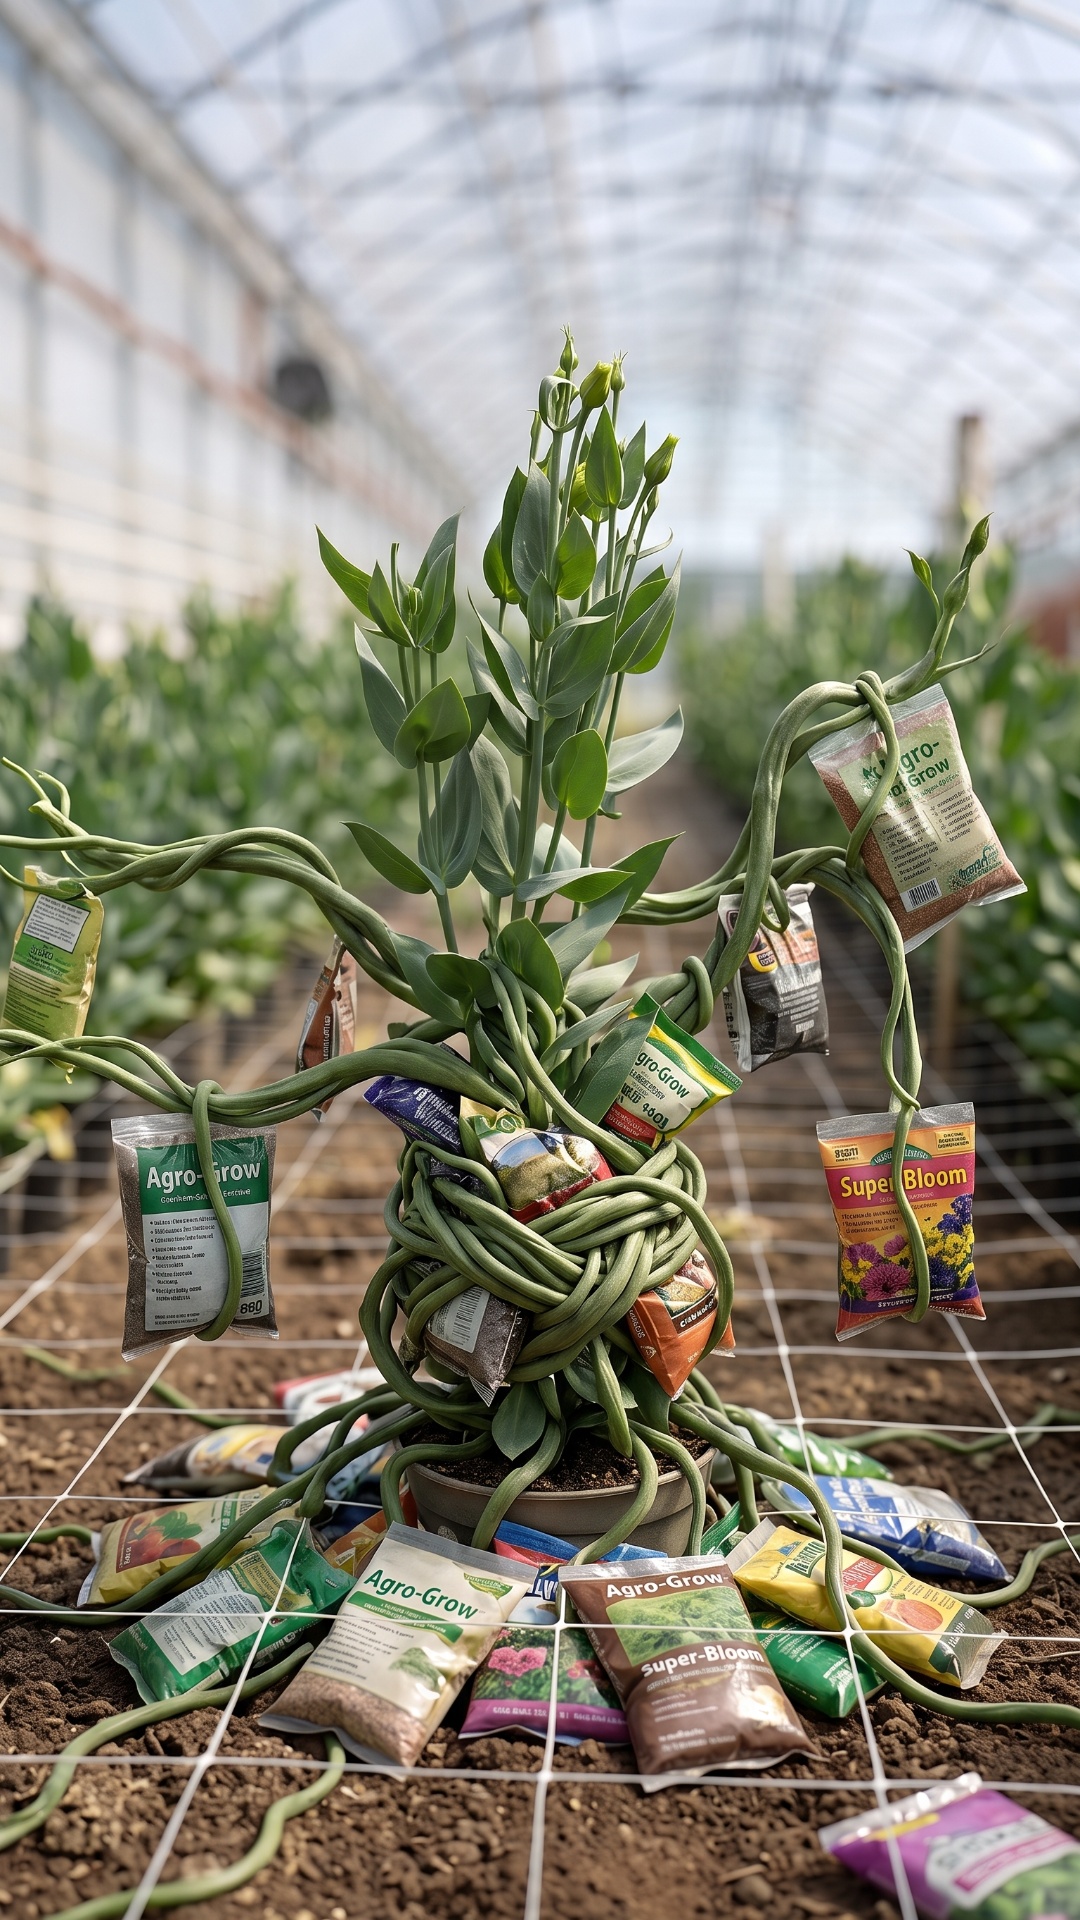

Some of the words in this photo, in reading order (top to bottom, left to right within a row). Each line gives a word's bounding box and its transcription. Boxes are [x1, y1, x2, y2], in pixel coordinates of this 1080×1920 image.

[907, 758, 950, 788] Grow
[903, 1168, 967, 1190] Bloom
[363, 1569, 479, 1620] Agro-Grow
[606, 1573, 724, 1599] Agro-Grow
